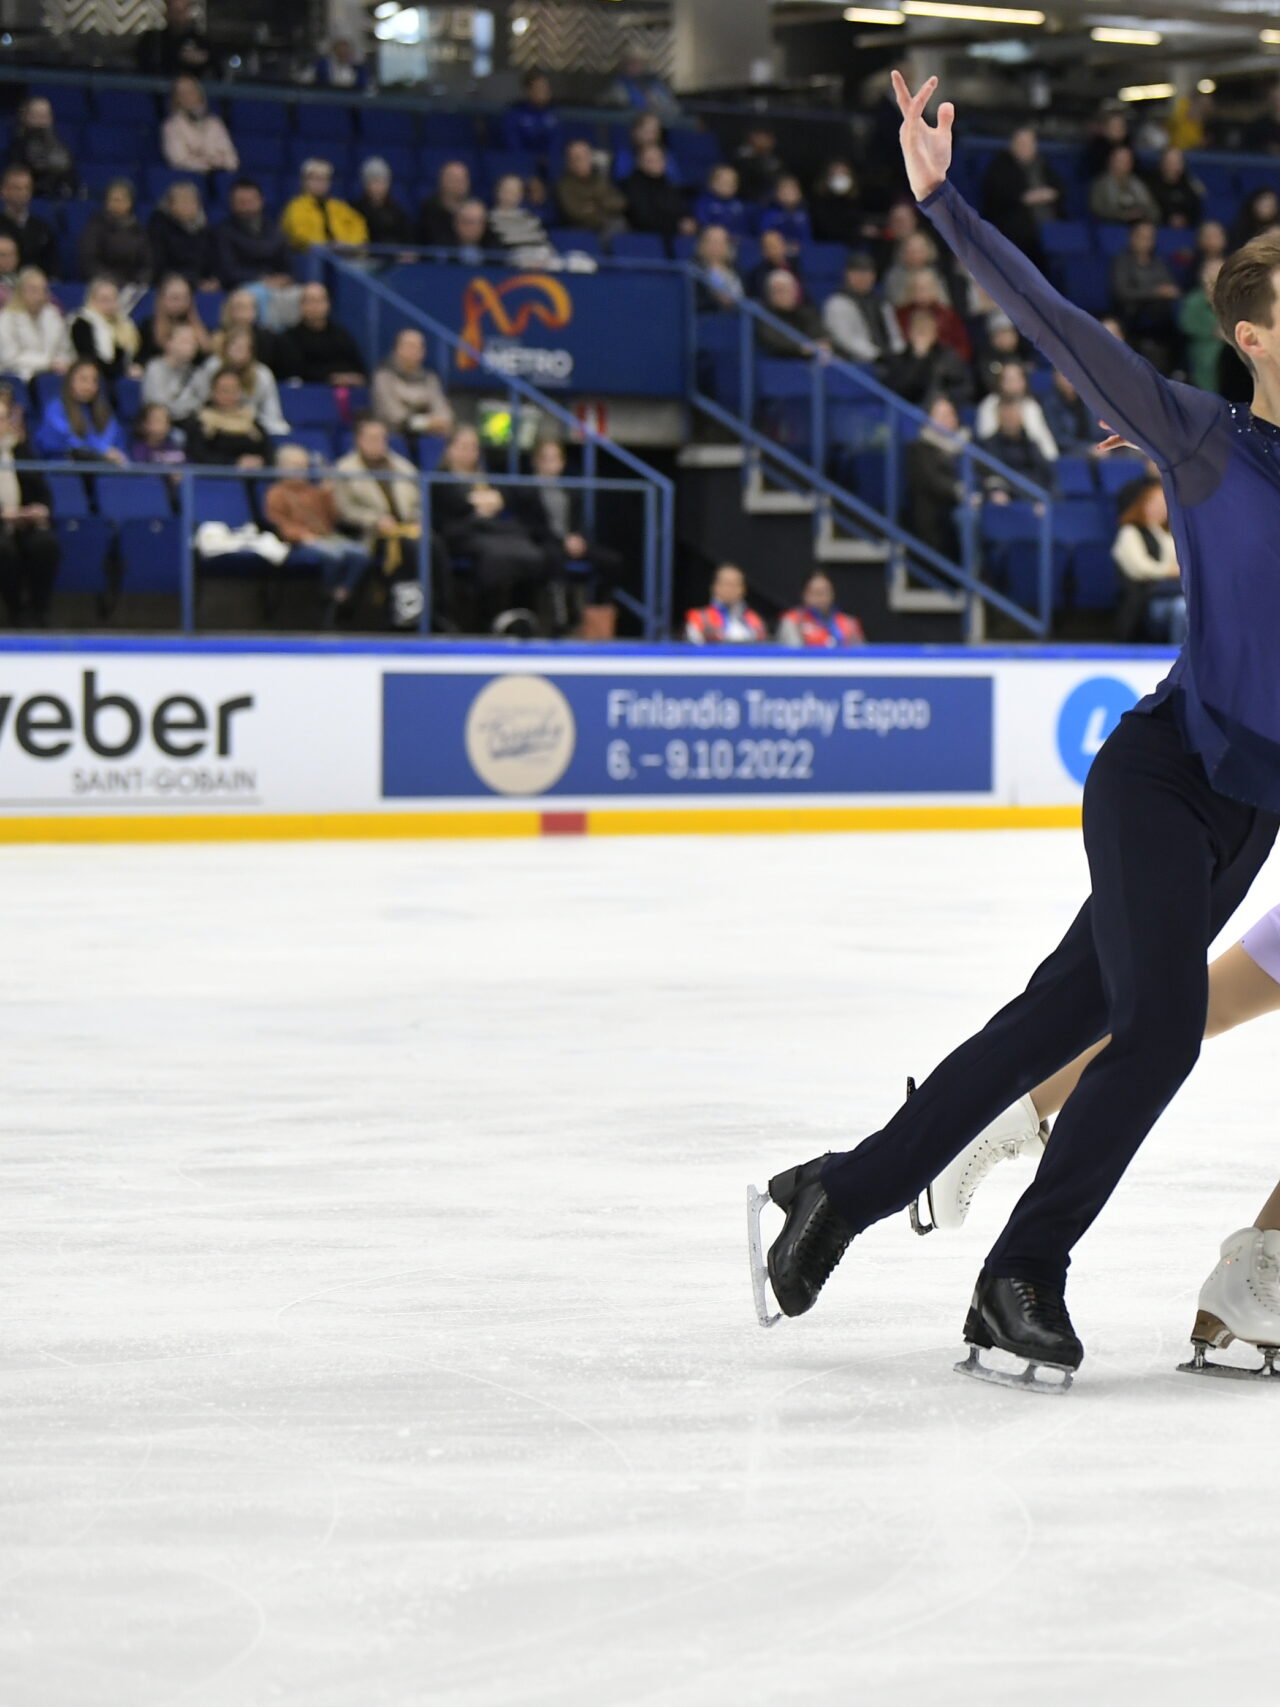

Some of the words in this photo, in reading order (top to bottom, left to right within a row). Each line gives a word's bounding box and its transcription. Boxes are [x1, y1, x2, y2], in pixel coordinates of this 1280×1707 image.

[607, 689, 741, 729] Finlandia
[745, 689, 838, 737] Trophy
[842, 689, 931, 737] Espoo
[607, 739, 637, 779] 6.
[665, 739, 814, 779] 9.10.2022
[72, 767, 257, 793] SAINT-GOBAIN
